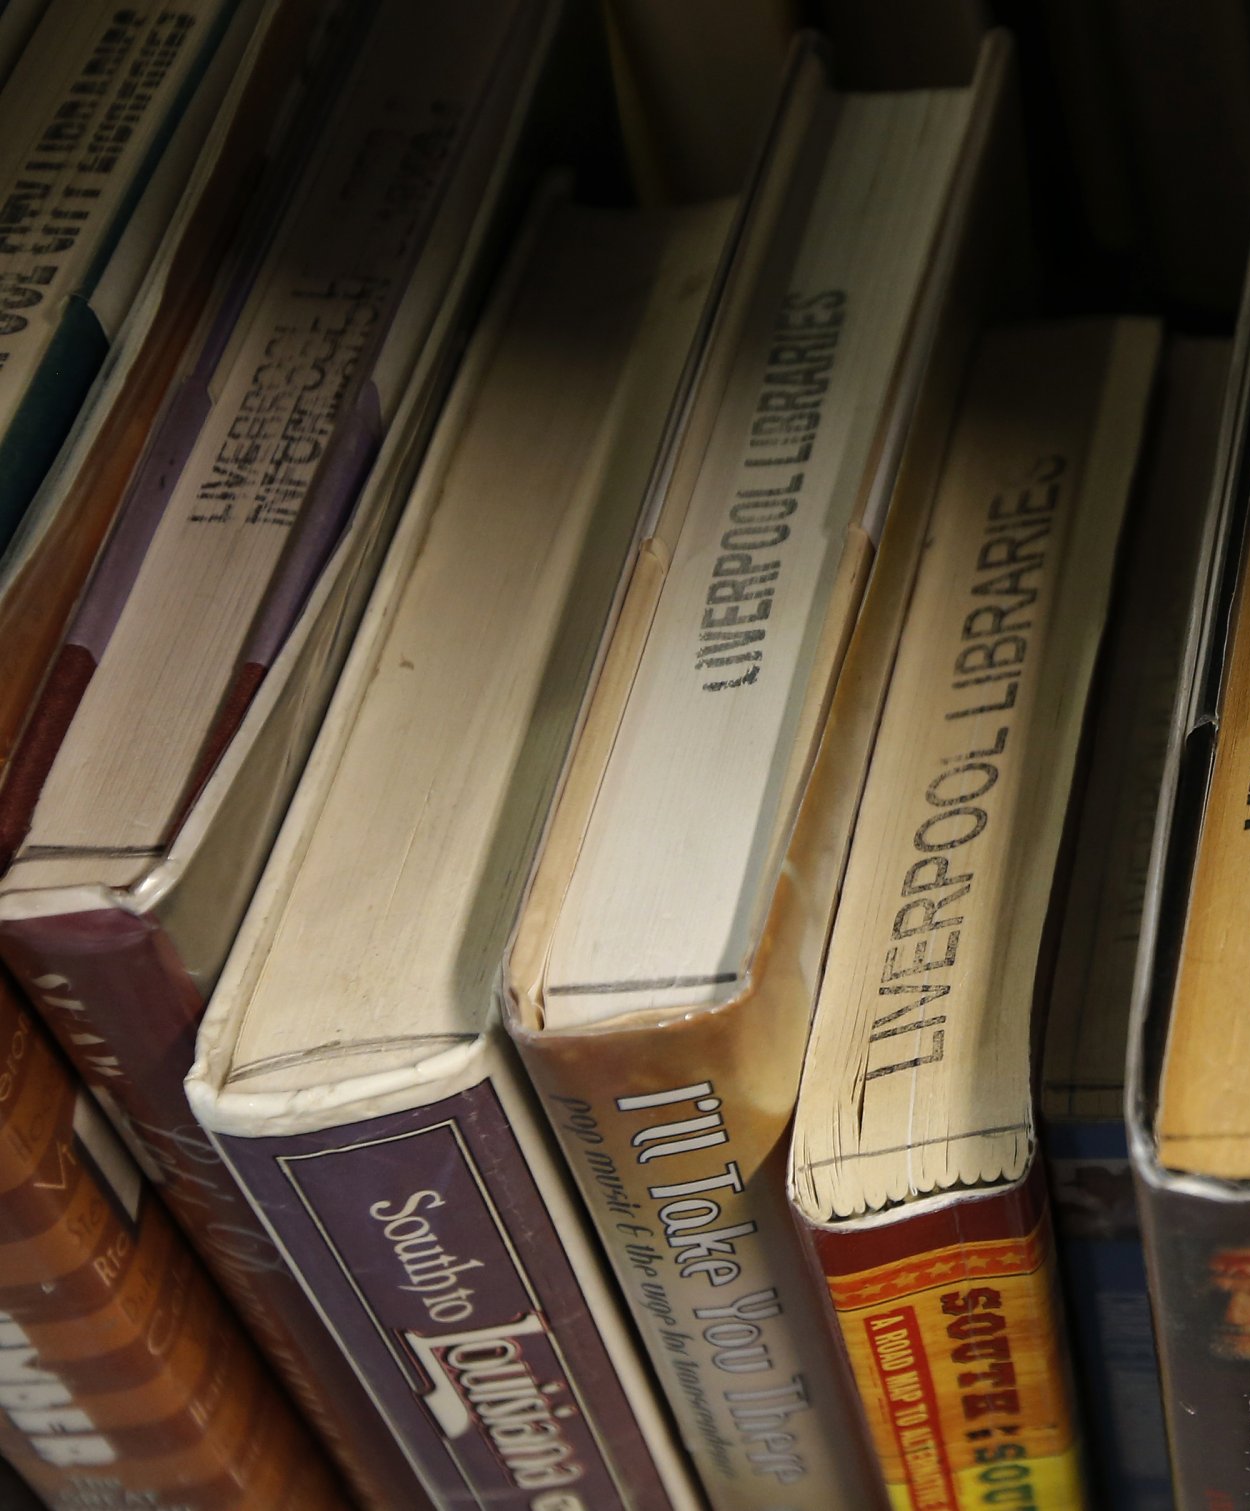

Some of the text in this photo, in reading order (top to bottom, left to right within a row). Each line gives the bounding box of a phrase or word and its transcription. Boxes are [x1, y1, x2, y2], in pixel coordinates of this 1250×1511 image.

[694, 287, 848, 692] LIVERPOOL LIBRARIES
[863, 453, 1068, 1083] LIVERPOOL LIBRARIES
[549, 1094, 604, 1146] pop
[586, 1147, 642, 1219] music
[368, 1189, 486, 1324] South to
[615, 1080, 810, 1485] I'll Take You There
[626, 1240, 667, 1281] the
[639, 1281, 677, 1328] urge
[869, 1314, 905, 1332] A
[658, 1325, 698, 1358] for
[873, 1328, 919, 1373] ROAD
[939, 1286, 1021, 1421] SOUTH
[400, 1308, 582, 1491] Louisiana
[884, 1371, 926, 1405] MAP
[893, 1402, 930, 1428] TO
